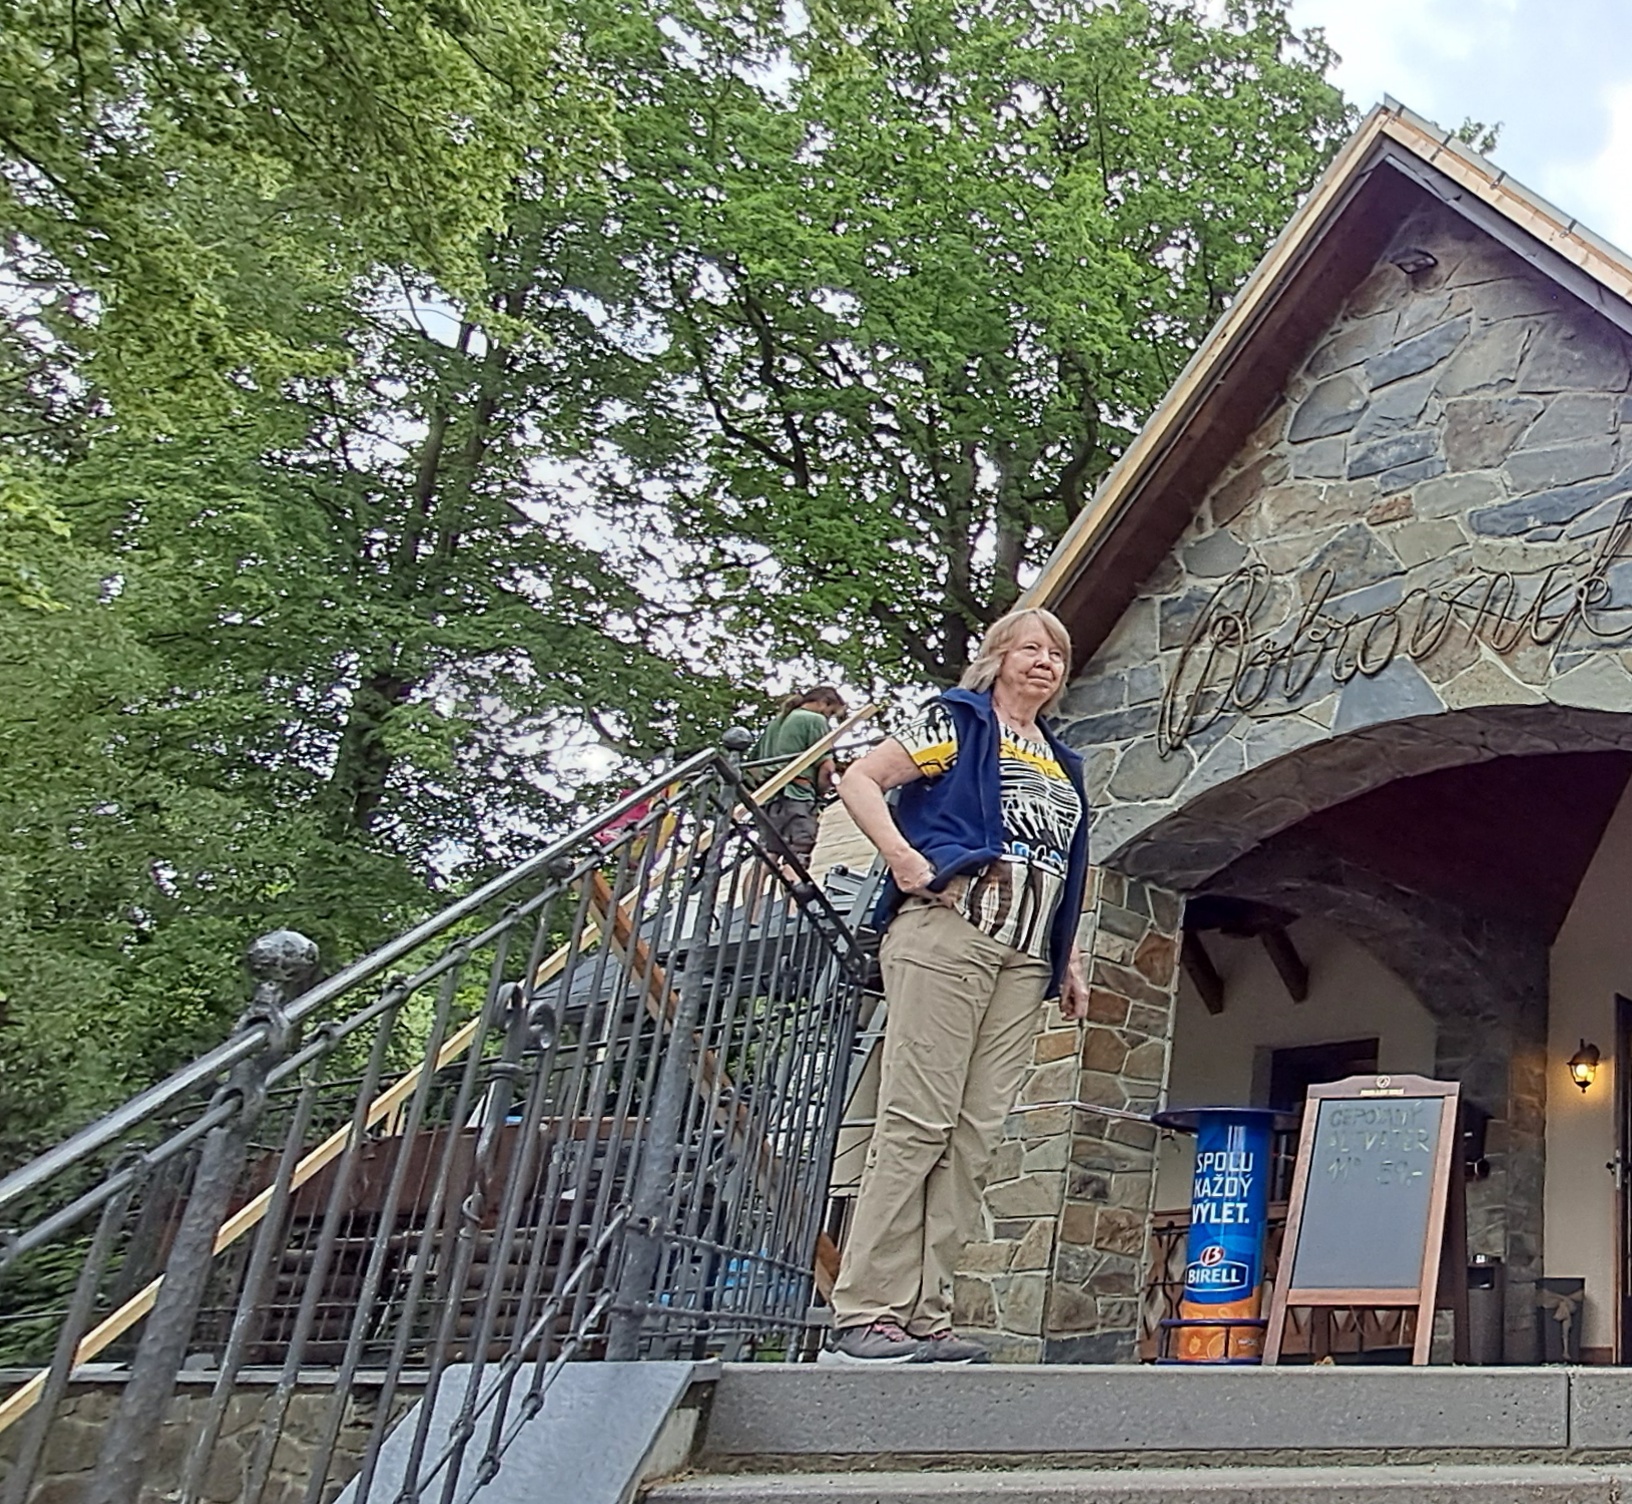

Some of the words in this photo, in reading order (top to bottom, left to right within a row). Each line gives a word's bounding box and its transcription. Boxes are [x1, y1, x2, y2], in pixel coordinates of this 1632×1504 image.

[1195, 1152, 1254, 1174] SPOLU
[1193, 1173, 1253, 1199] KAŽDÝ
[1191, 1199, 1250, 1224] VÝLET.
[1187, 1268, 1241, 1284] BIRELL
